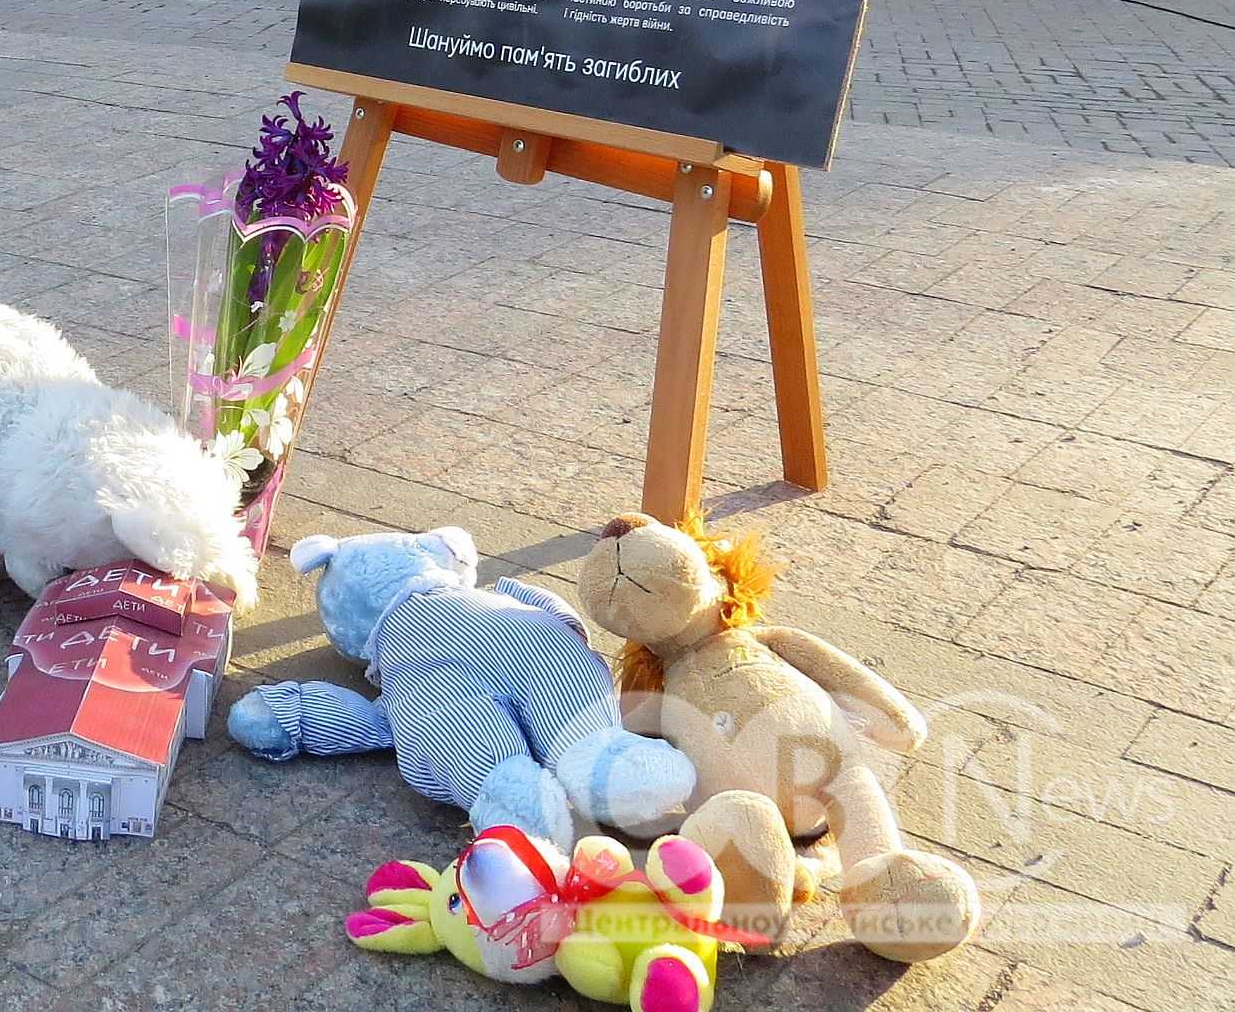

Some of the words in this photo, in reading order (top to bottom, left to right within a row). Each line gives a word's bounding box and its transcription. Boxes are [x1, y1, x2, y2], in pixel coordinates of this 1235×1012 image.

[677, 5, 692, 15] за
[609, 15, 641, 28] жертв
[408, 25, 495, 60] Шануймо
[581, 54, 681, 89] загиблих
[66, 568, 179, 598] ДЕТИ
[112, 599, 146, 612] ДЕТИ
[60, 625, 176, 663] ДЕТИ
